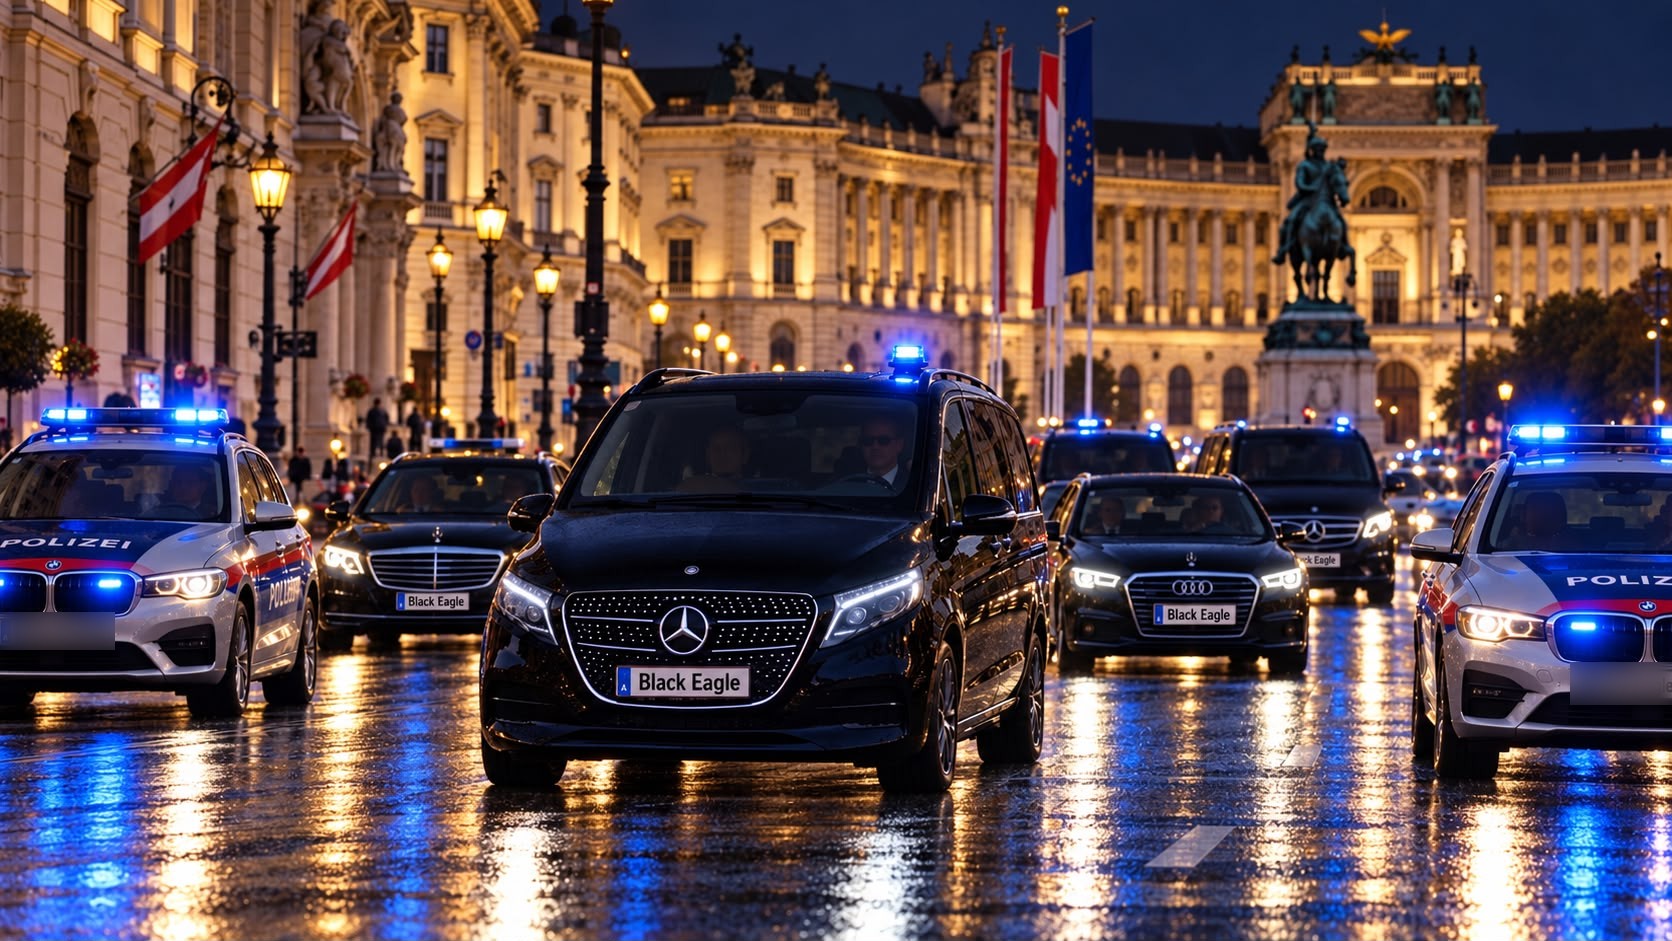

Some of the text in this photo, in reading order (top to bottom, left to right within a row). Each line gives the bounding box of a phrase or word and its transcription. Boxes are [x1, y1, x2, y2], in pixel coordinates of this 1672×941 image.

[0, 537, 131, 549] POLIZEI
[1314, 555, 1336, 566] Eagle
[408, 596, 434, 607] Black
[437, 596, 465, 609] Eagle
[1167, 608, 1197, 621] Black
[1201, 608, 1230, 623] Eagle
[639, 672, 741, 695] Black Eagle
